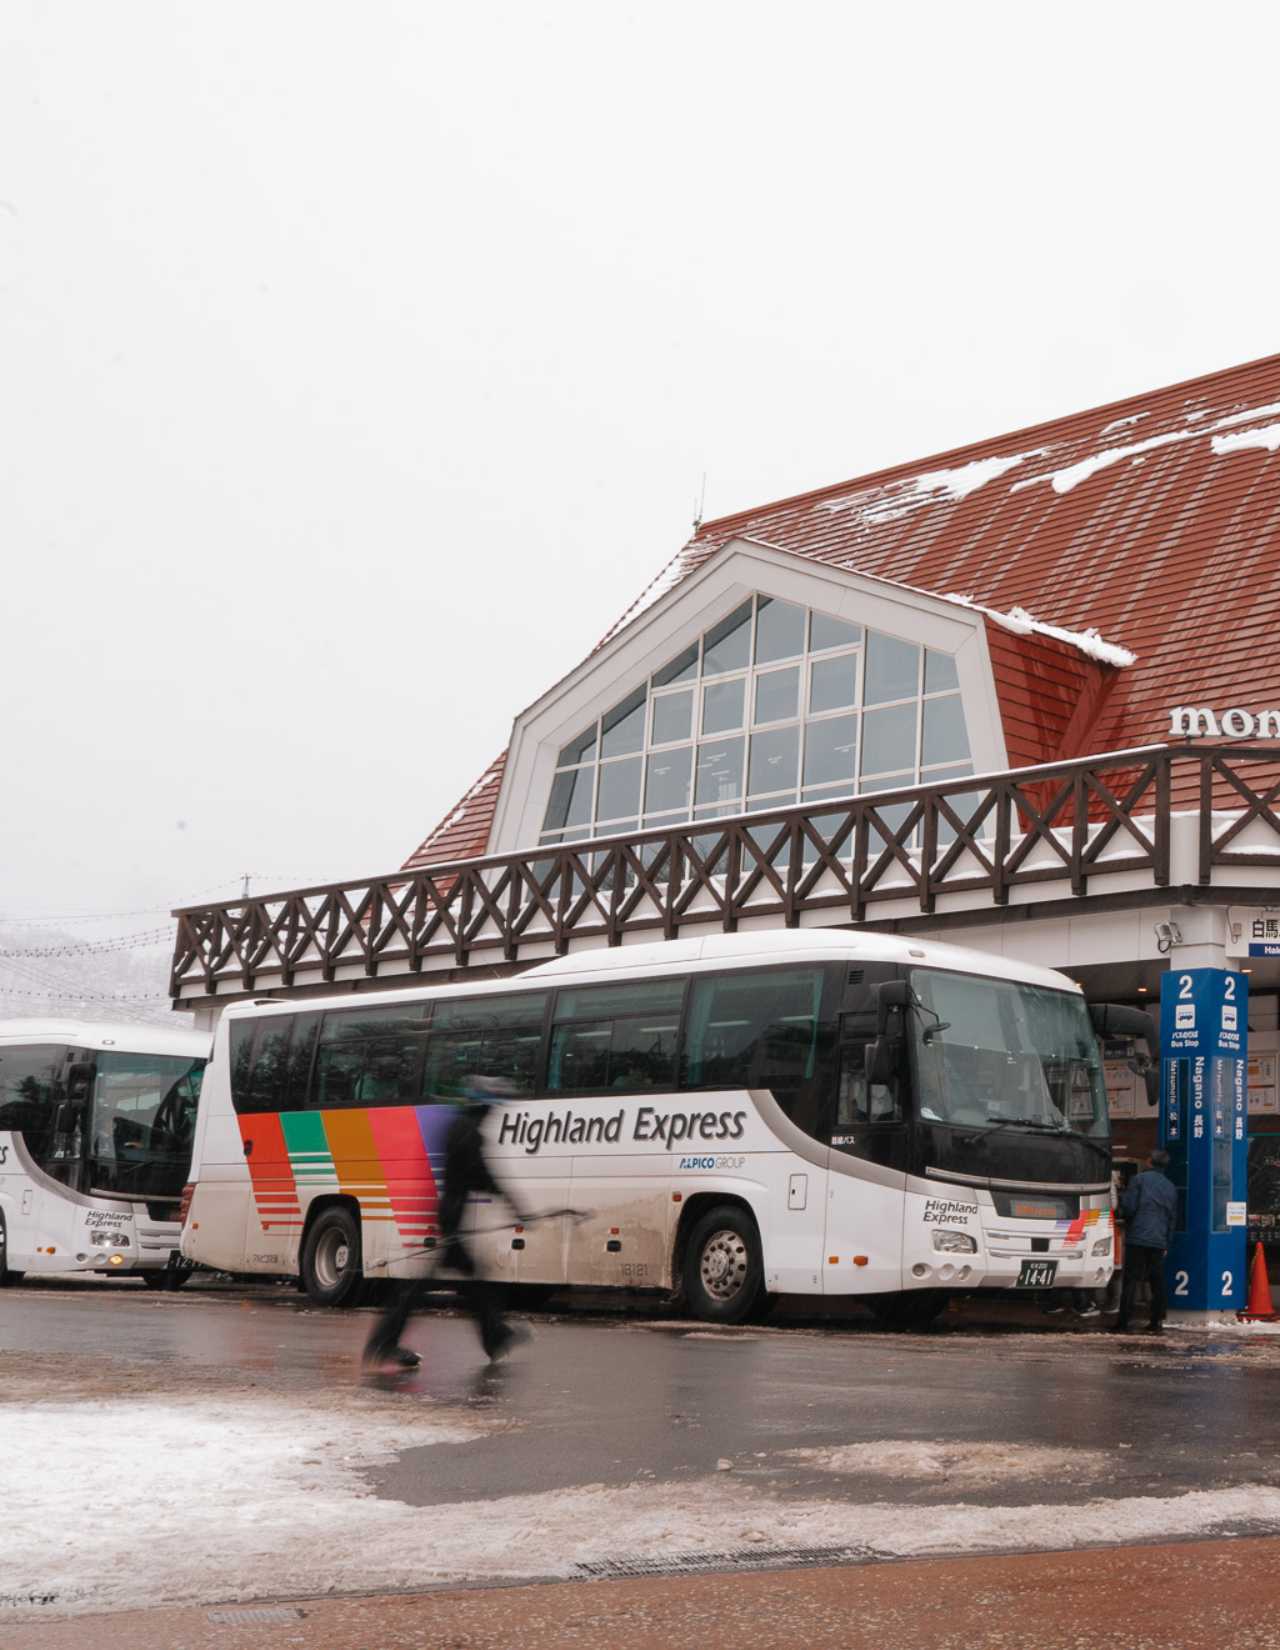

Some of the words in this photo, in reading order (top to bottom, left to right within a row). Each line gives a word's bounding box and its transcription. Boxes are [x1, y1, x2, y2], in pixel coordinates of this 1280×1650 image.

[1179, 975, 1193, 999] 2
[1224, 976, 1236, 1000] 2
[1184, 1040, 1200, 1048] Stop
[1192, 1056, 1205, 1109] Nagano
[1235, 1059, 1244, 1111] Nagano
[498, 1108, 624, 1154] Highland
[632, 1107, 748, 1150] Express
[679, 1157, 715, 1169] ALPICO
[715, 1157, 745, 1168] GROUP
[87, 1210, 133, 1223] Highland
[924, 1200, 978, 1215] Highland
[84, 1218, 123, 1229] Express
[923, 1211, 968, 1225] Express
[1024, 1269, 1053, 1286] 14-41
[1175, 1270, 1189, 1296] 2
[1222, 1270, 1232, 1296] 2
